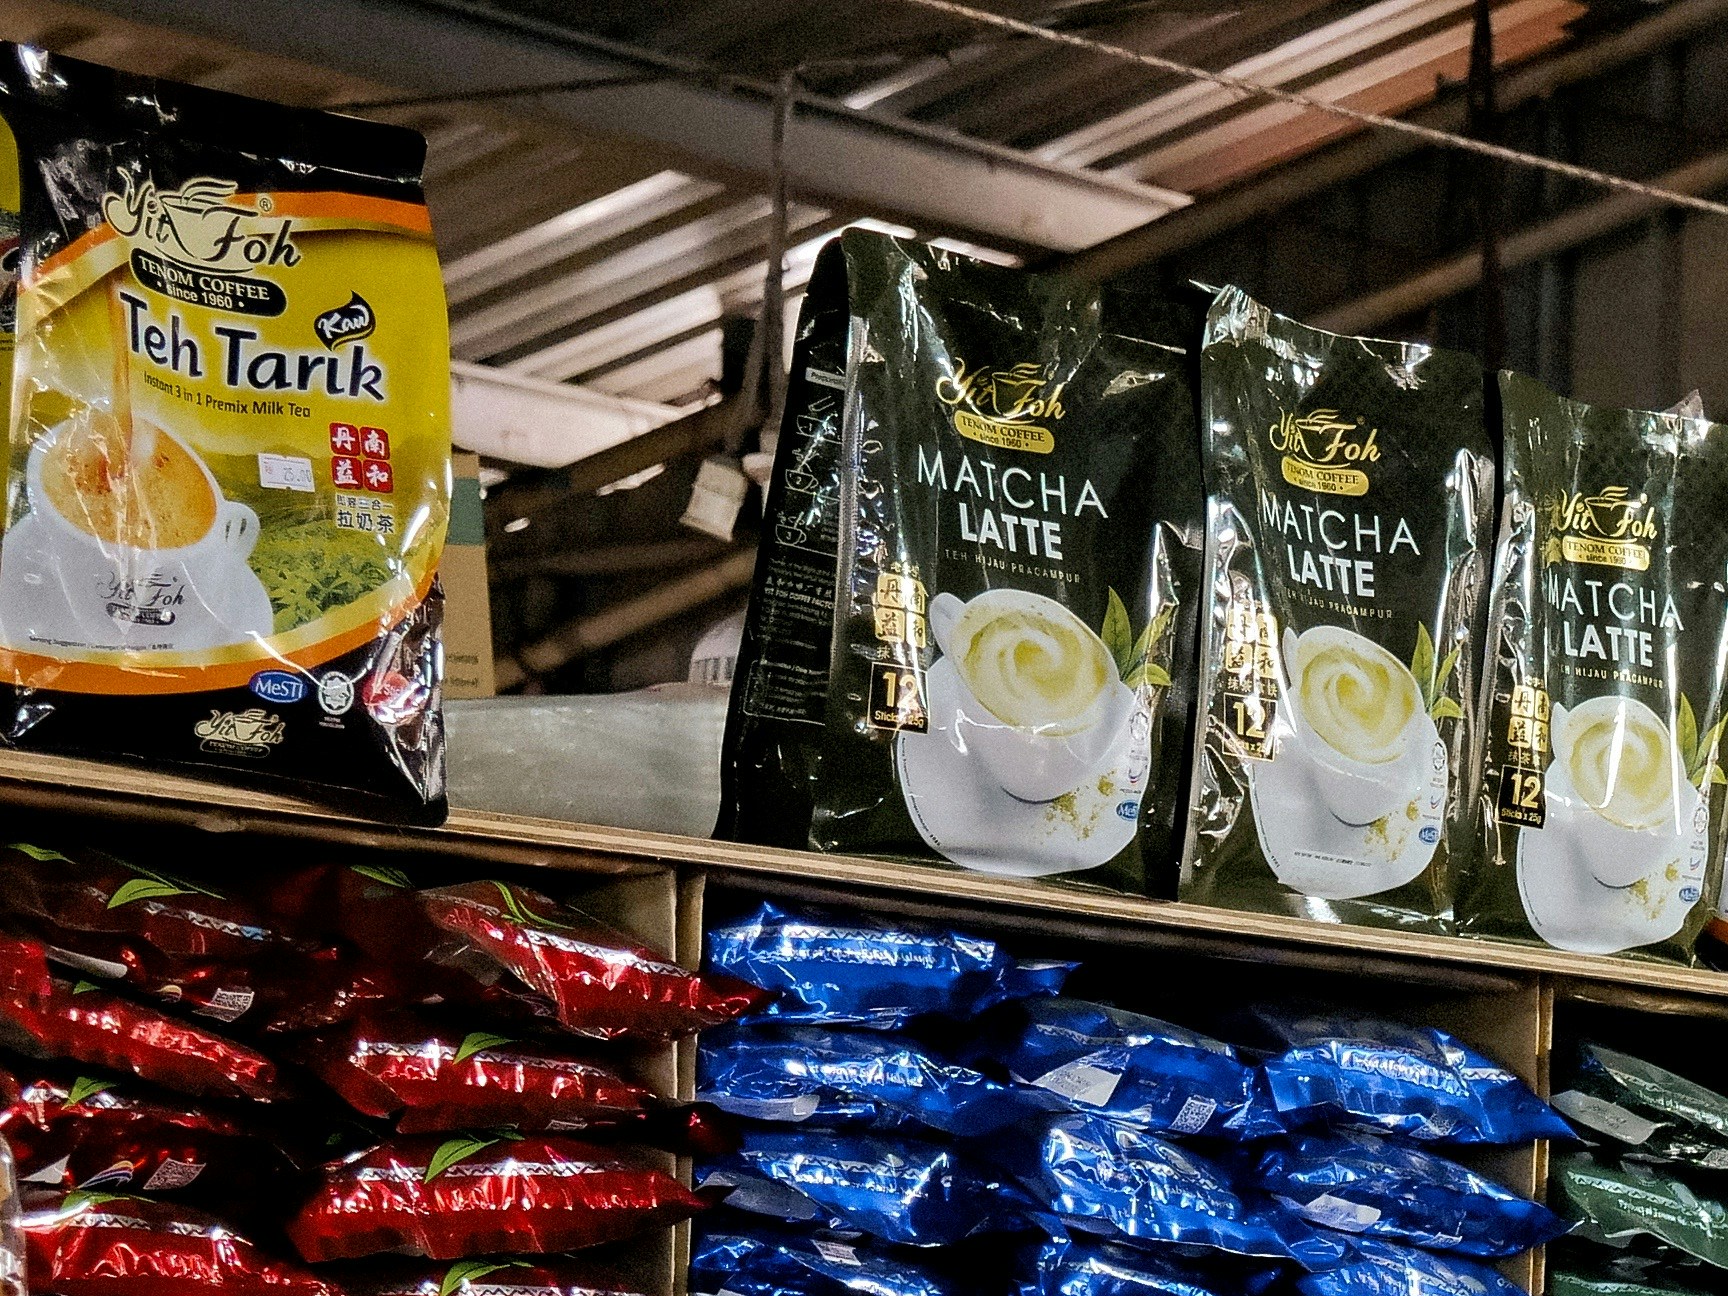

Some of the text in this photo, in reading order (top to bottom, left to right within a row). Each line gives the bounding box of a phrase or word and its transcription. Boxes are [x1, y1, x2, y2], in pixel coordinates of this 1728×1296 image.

[103, 167, 301, 269] Yit Foh
[138, 254, 270, 301] TENOM COFFEE
[166, 285, 232, 309] since 1960
[318, 304, 370, 339] Kaw
[119, 292, 384, 401] Teh Tarik
[143, 371, 310, 418] Instant 3 in 1 Premix Milk Tea
[332, 427, 386, 457] 丹南
[961, 416, 1045, 442] TENOM COFFEE
[1002, 435, 1022, 448] 1960
[1318, 424, 1381, 462] Foh
[334, 459, 390, 487] 益和
[918, 444, 1109, 519] MATCHA
[1317, 471, 1359, 484] COFFEE
[337, 511, 395, 534] 拉奶茶
[959, 503, 1063, 560] LATTE
[1262, 487, 1421, 556] MATCHA
[1557, 489, 1658, 540] Yit Foh
[945, 549, 1080, 583] TEH HIJAU PRACAMPUR
[1567, 541, 1605, 554] TENOM
[1287, 544, 1375, 597] LATTE
[1549, 567, 1685, 631] MATCHA
[1564, 621, 1653, 668] LATTE
[255, 678, 303, 700] MeSTI
[883, 671, 918, 708] 12
[1511, 773, 1541, 809] 12
